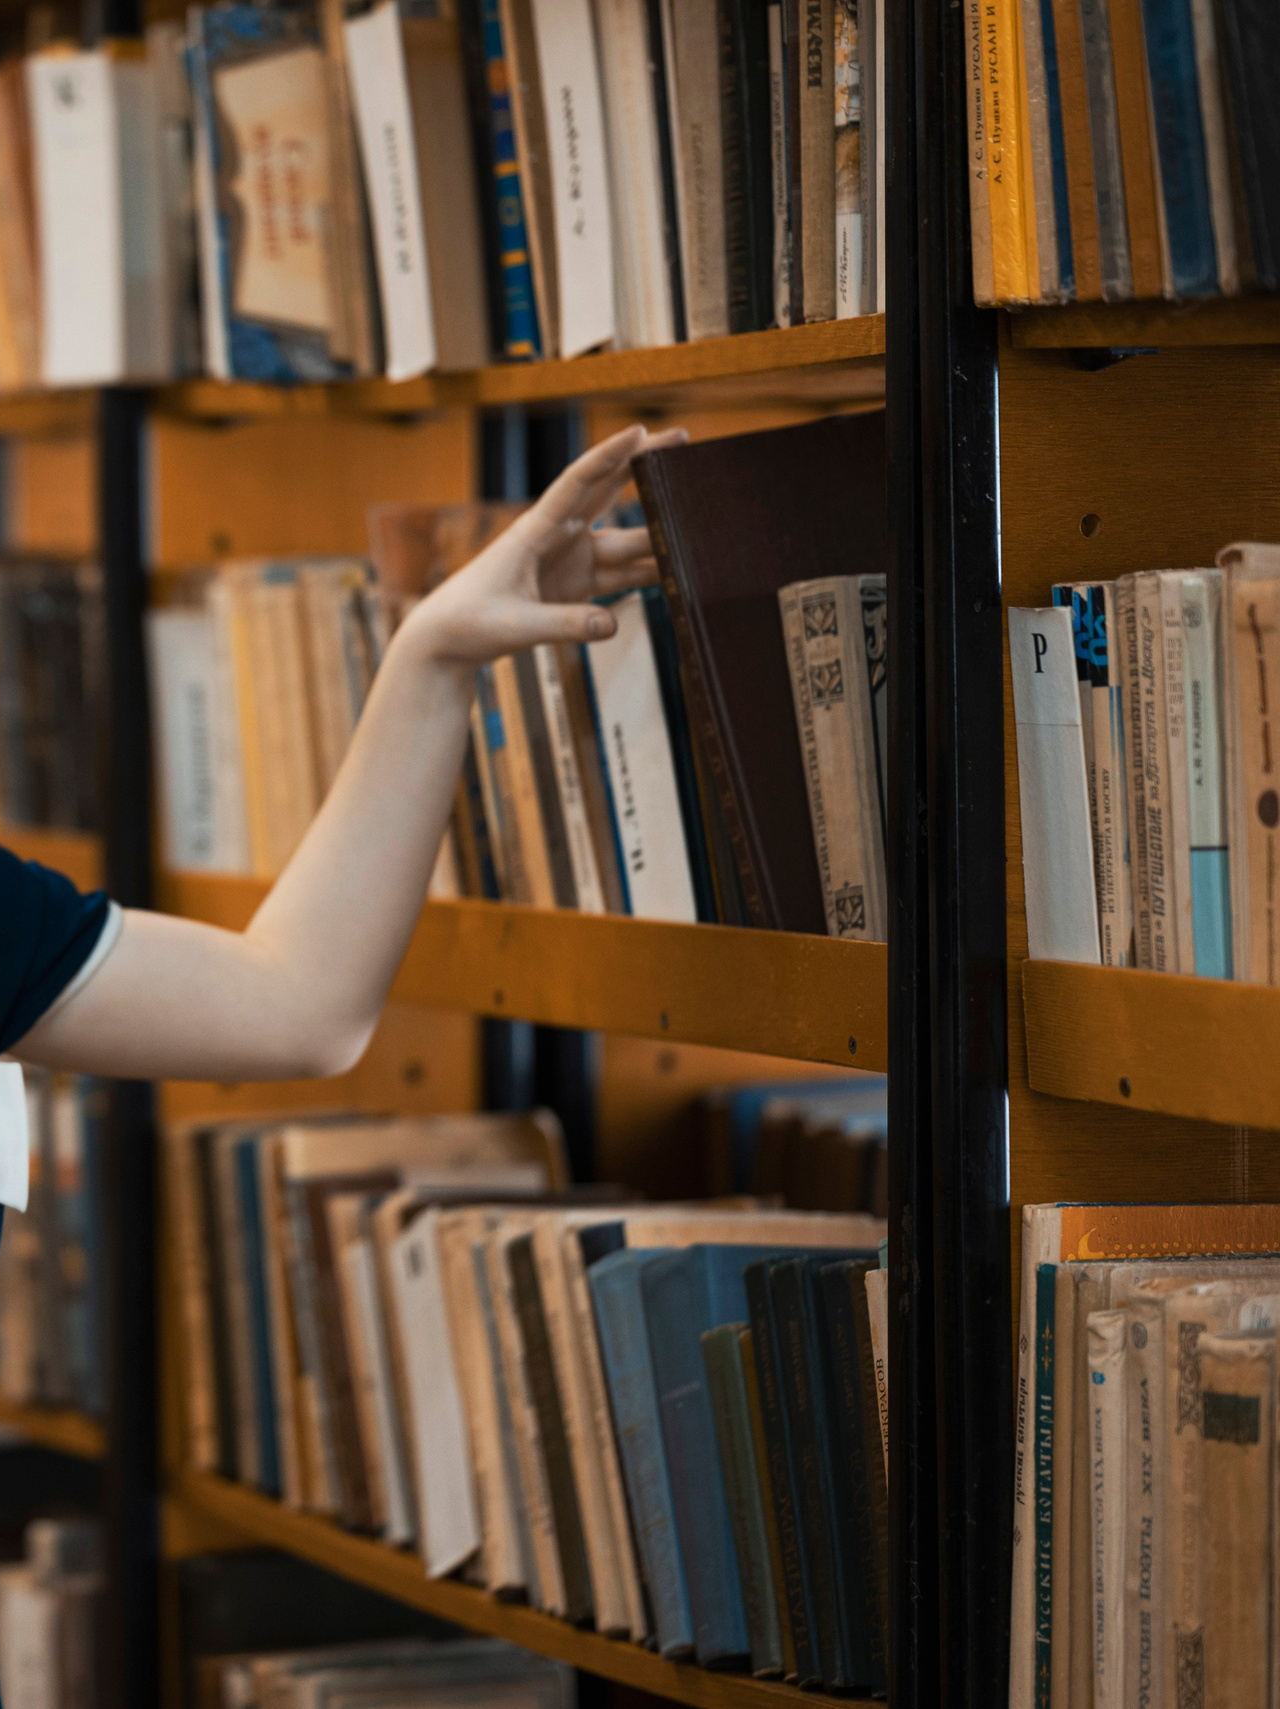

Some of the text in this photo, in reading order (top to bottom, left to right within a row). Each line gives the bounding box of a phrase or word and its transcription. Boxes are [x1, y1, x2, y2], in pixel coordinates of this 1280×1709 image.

[807, 0, 823, 90] ИЗУМ
[971, 20, 982, 81] РУСЛАН
[986, 23, 999, 84] РУСЛАН
[974, 88, 985, 141] Пушкин
[990, 91, 1003, 144] Пушкин
[1031, 632, 1048, 674] Р
[1125, 607, 1138, 665] МОСКВУ
[1130, 681, 1143, 768] ПЕТЕРБУРГА
[1102, 768, 1111, 814] МОСКВУ
[1104, 828, 1115, 895] ПЕТЕРБУРГА
[1147, 806, 1167, 917] ПУТЕШЕСТВИЕ
[1093, 1407, 1104, 1454] ВЕКА
[1138, 1377, 1152, 1442] ВЕКА
[1093, 1457, 1105, 1492] XIX
[1141, 1450, 1153, 1496] XIX
[1138, 1516, 1153, 1601] ПОЭТЫ
